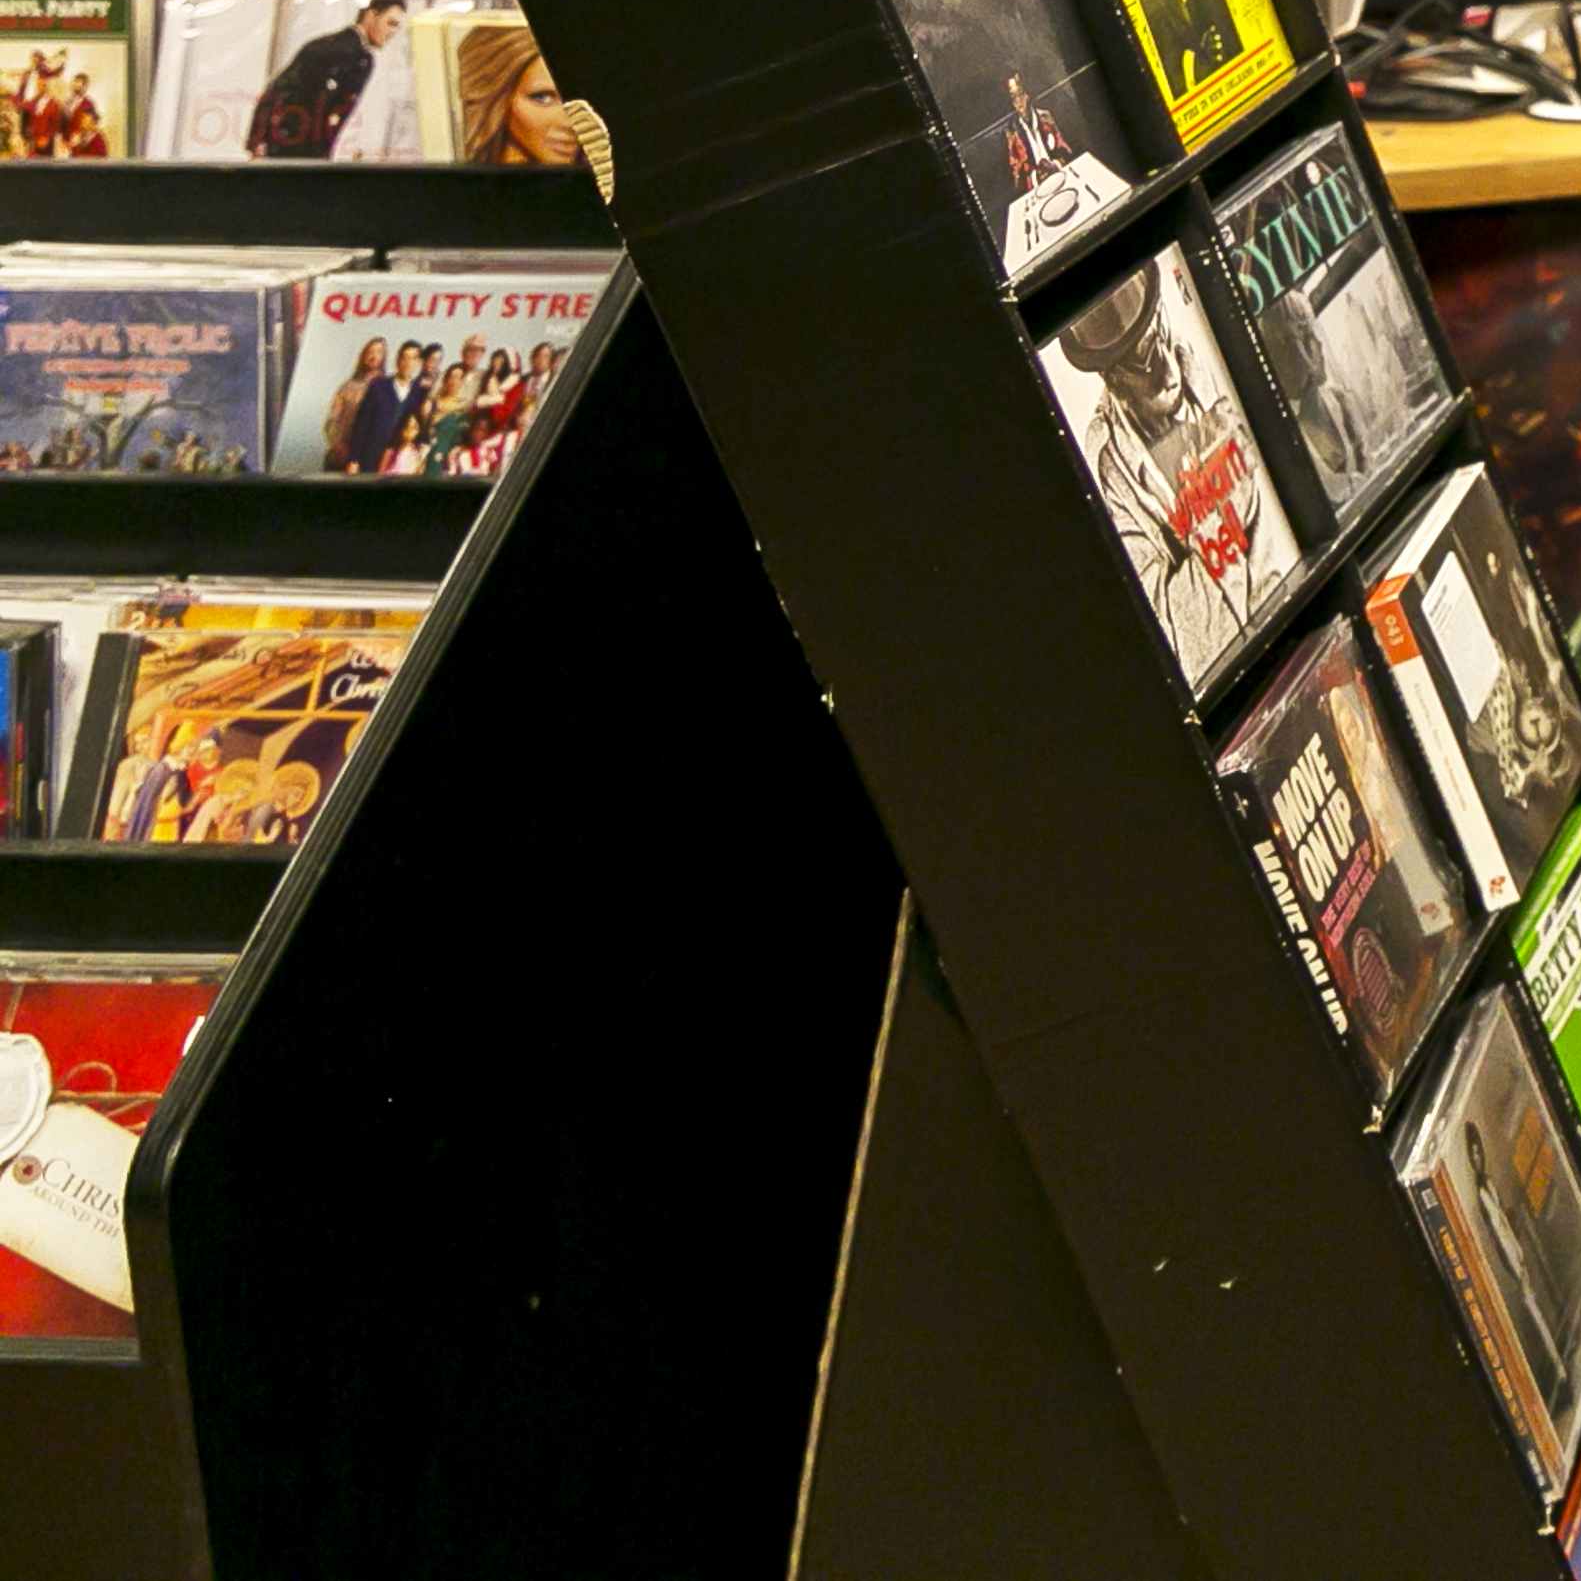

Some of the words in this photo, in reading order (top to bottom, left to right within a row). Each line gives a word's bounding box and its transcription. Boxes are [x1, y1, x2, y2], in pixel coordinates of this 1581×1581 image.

[1229, 164, 1369, 317] SYLVIE
[322, 292, 492, 322] QUALITY
[501, 292, 596, 319] STRE
[1164, 437, 1249, 541] william
[1195, 499, 1250, 582] bell
[1271, 731, 1338, 850] MOVE
[1297, 821, 1339, 904] ON
[1320, 786, 1356, 861] UP
[42, 1157, 120, 1218] CHRIS
